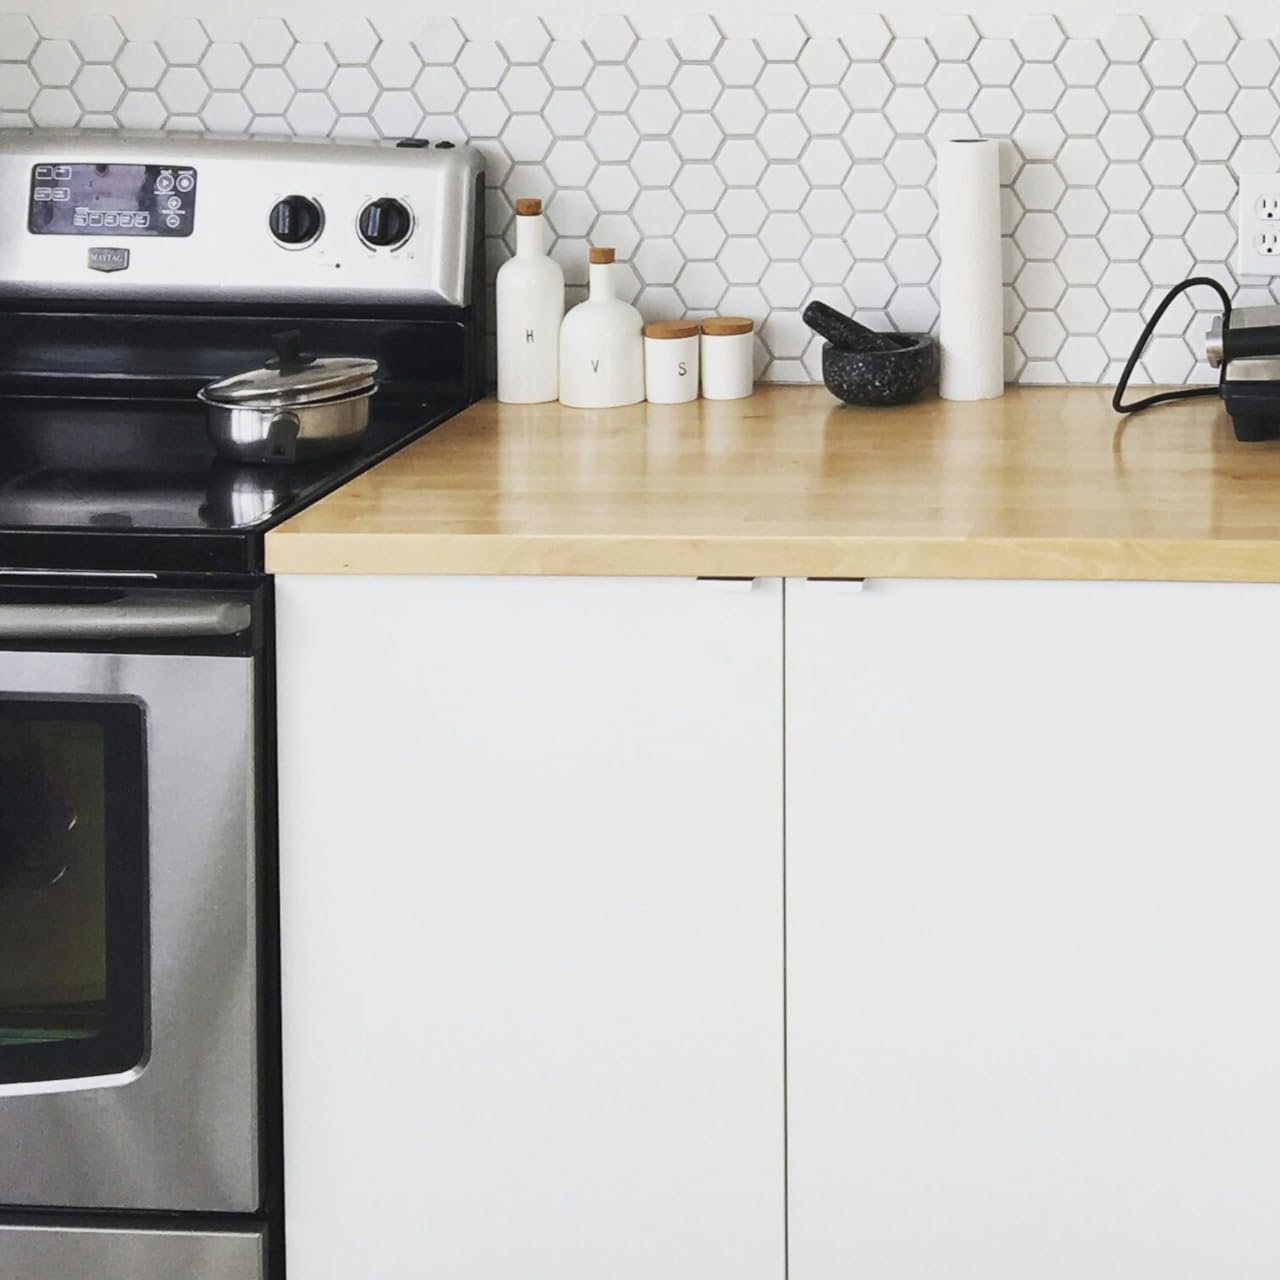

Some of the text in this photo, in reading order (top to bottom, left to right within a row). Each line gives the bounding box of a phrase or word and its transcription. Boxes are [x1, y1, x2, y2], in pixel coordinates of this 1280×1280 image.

[526, 329, 534, 344] H
[591, 359, 600, 373] V
[678, 362, 687, 376] S
